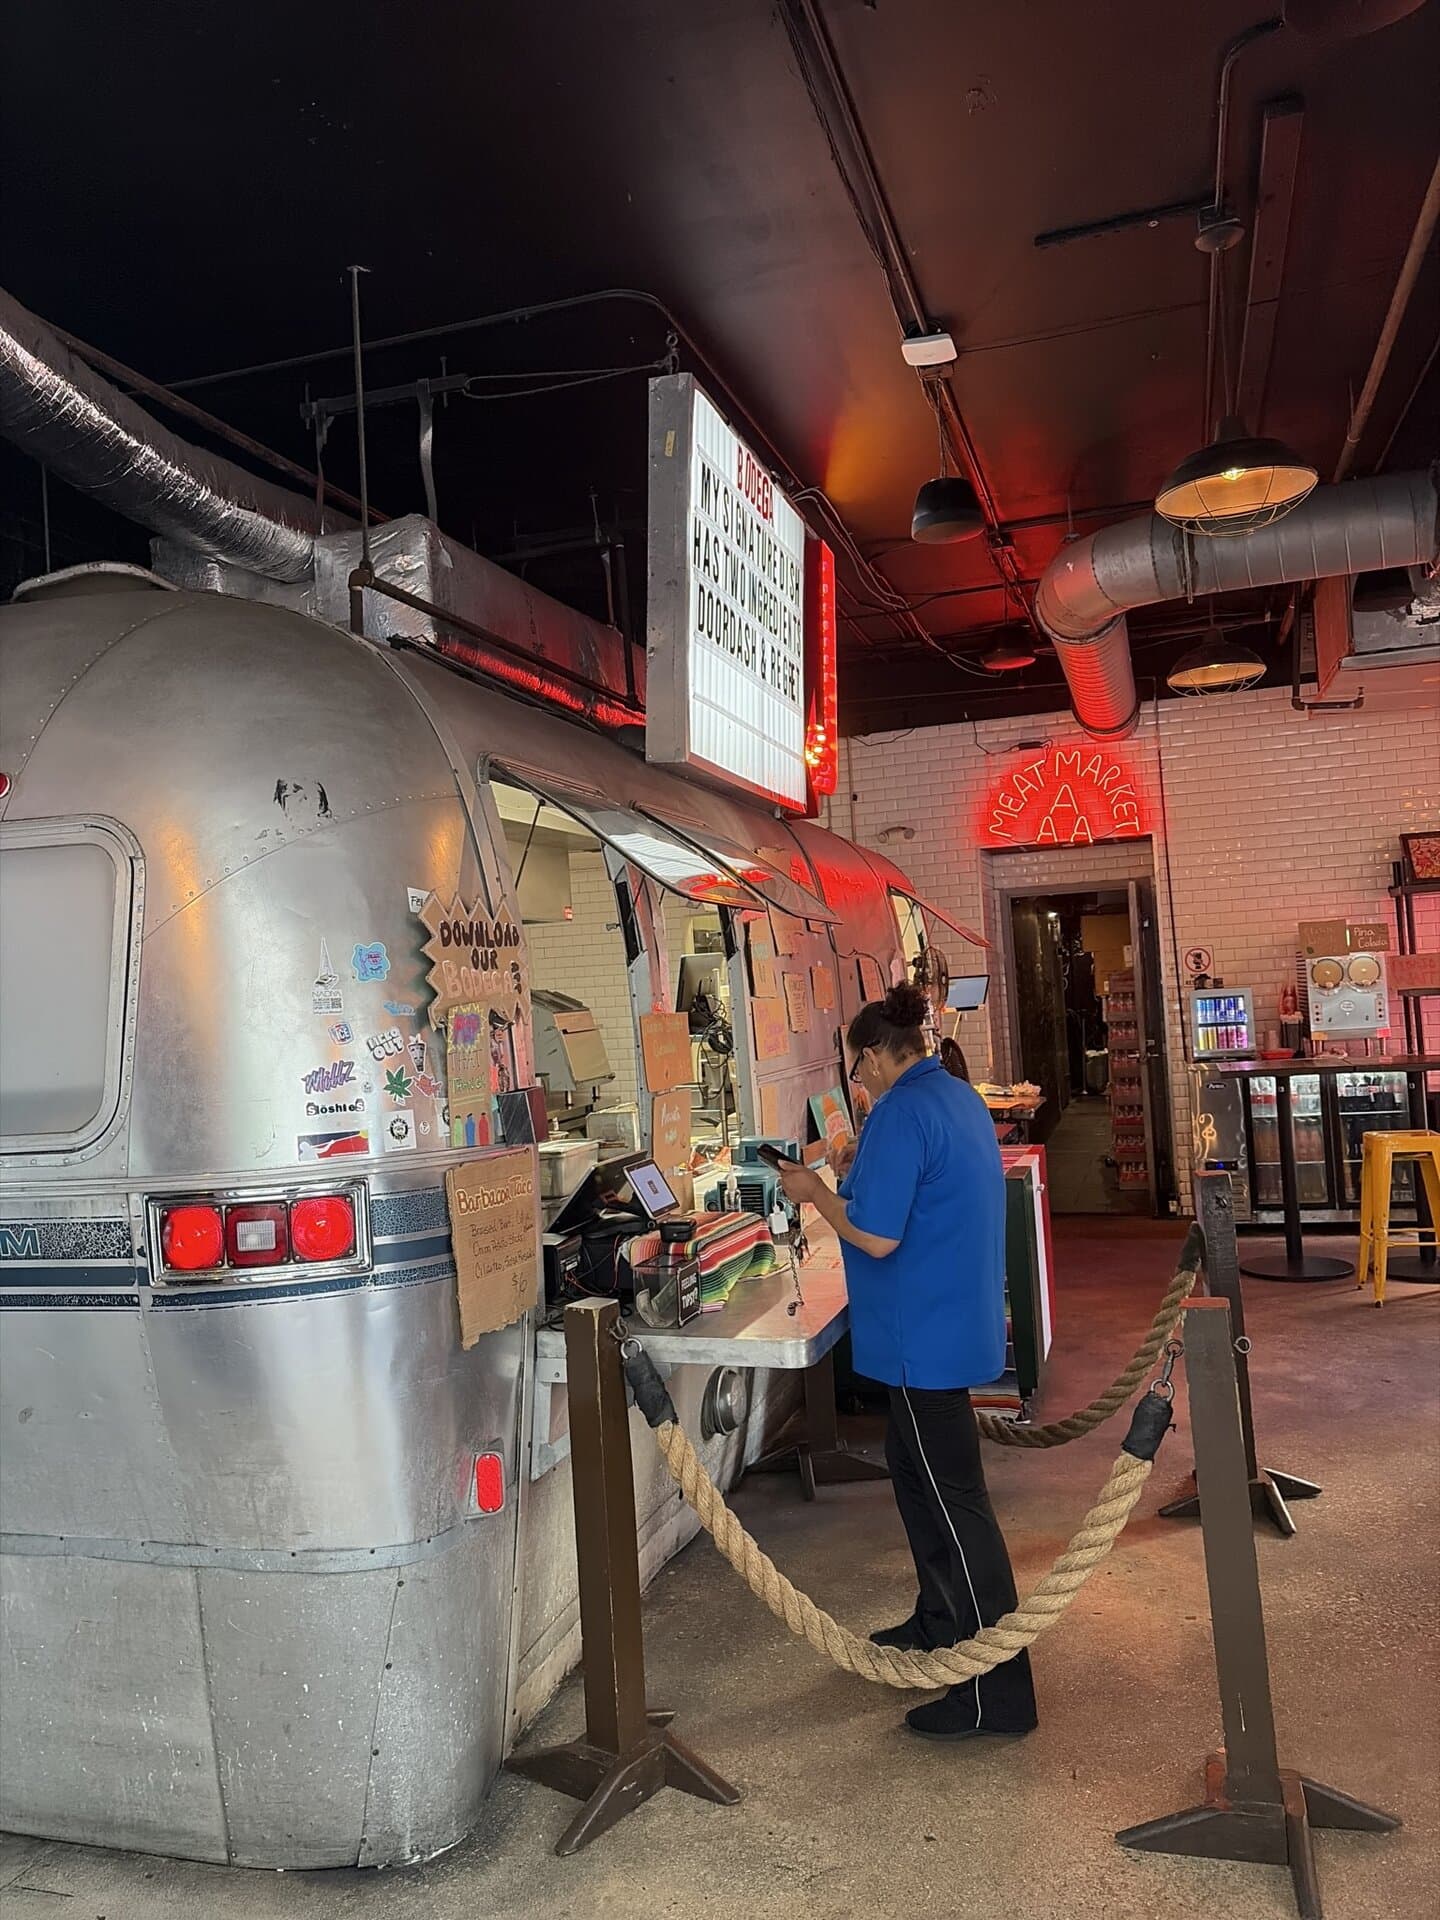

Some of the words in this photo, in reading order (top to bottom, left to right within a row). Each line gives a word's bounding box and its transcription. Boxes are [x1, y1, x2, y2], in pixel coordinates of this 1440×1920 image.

[737, 443, 775, 529] BODEGA
[701, 460, 721, 523] MY
[722, 484, 778, 586] SIGNATURE
[779, 549, 801, 608] DISH
[693, 515, 720, 584] HAS
[723, 547, 746, 608] TWO
[747, 570, 801, 659] INGREDIENTS
[698, 583, 757, 673] DOORDASH
[760, 637, 767, 681] &
[988, 758, 1047, 838] MEAT
[1055, 750, 1141, 832] MARKET
[1049, 783, 1080, 816] A
[439, 919, 521, 949] DOWNLOAD
[470, 947, 499, 972] OUR
[372, 1036, 404, 1061] OUT
[455, 1186, 512, 1216] Barbacoa
[509, 1174, 535, 1199] Taco
